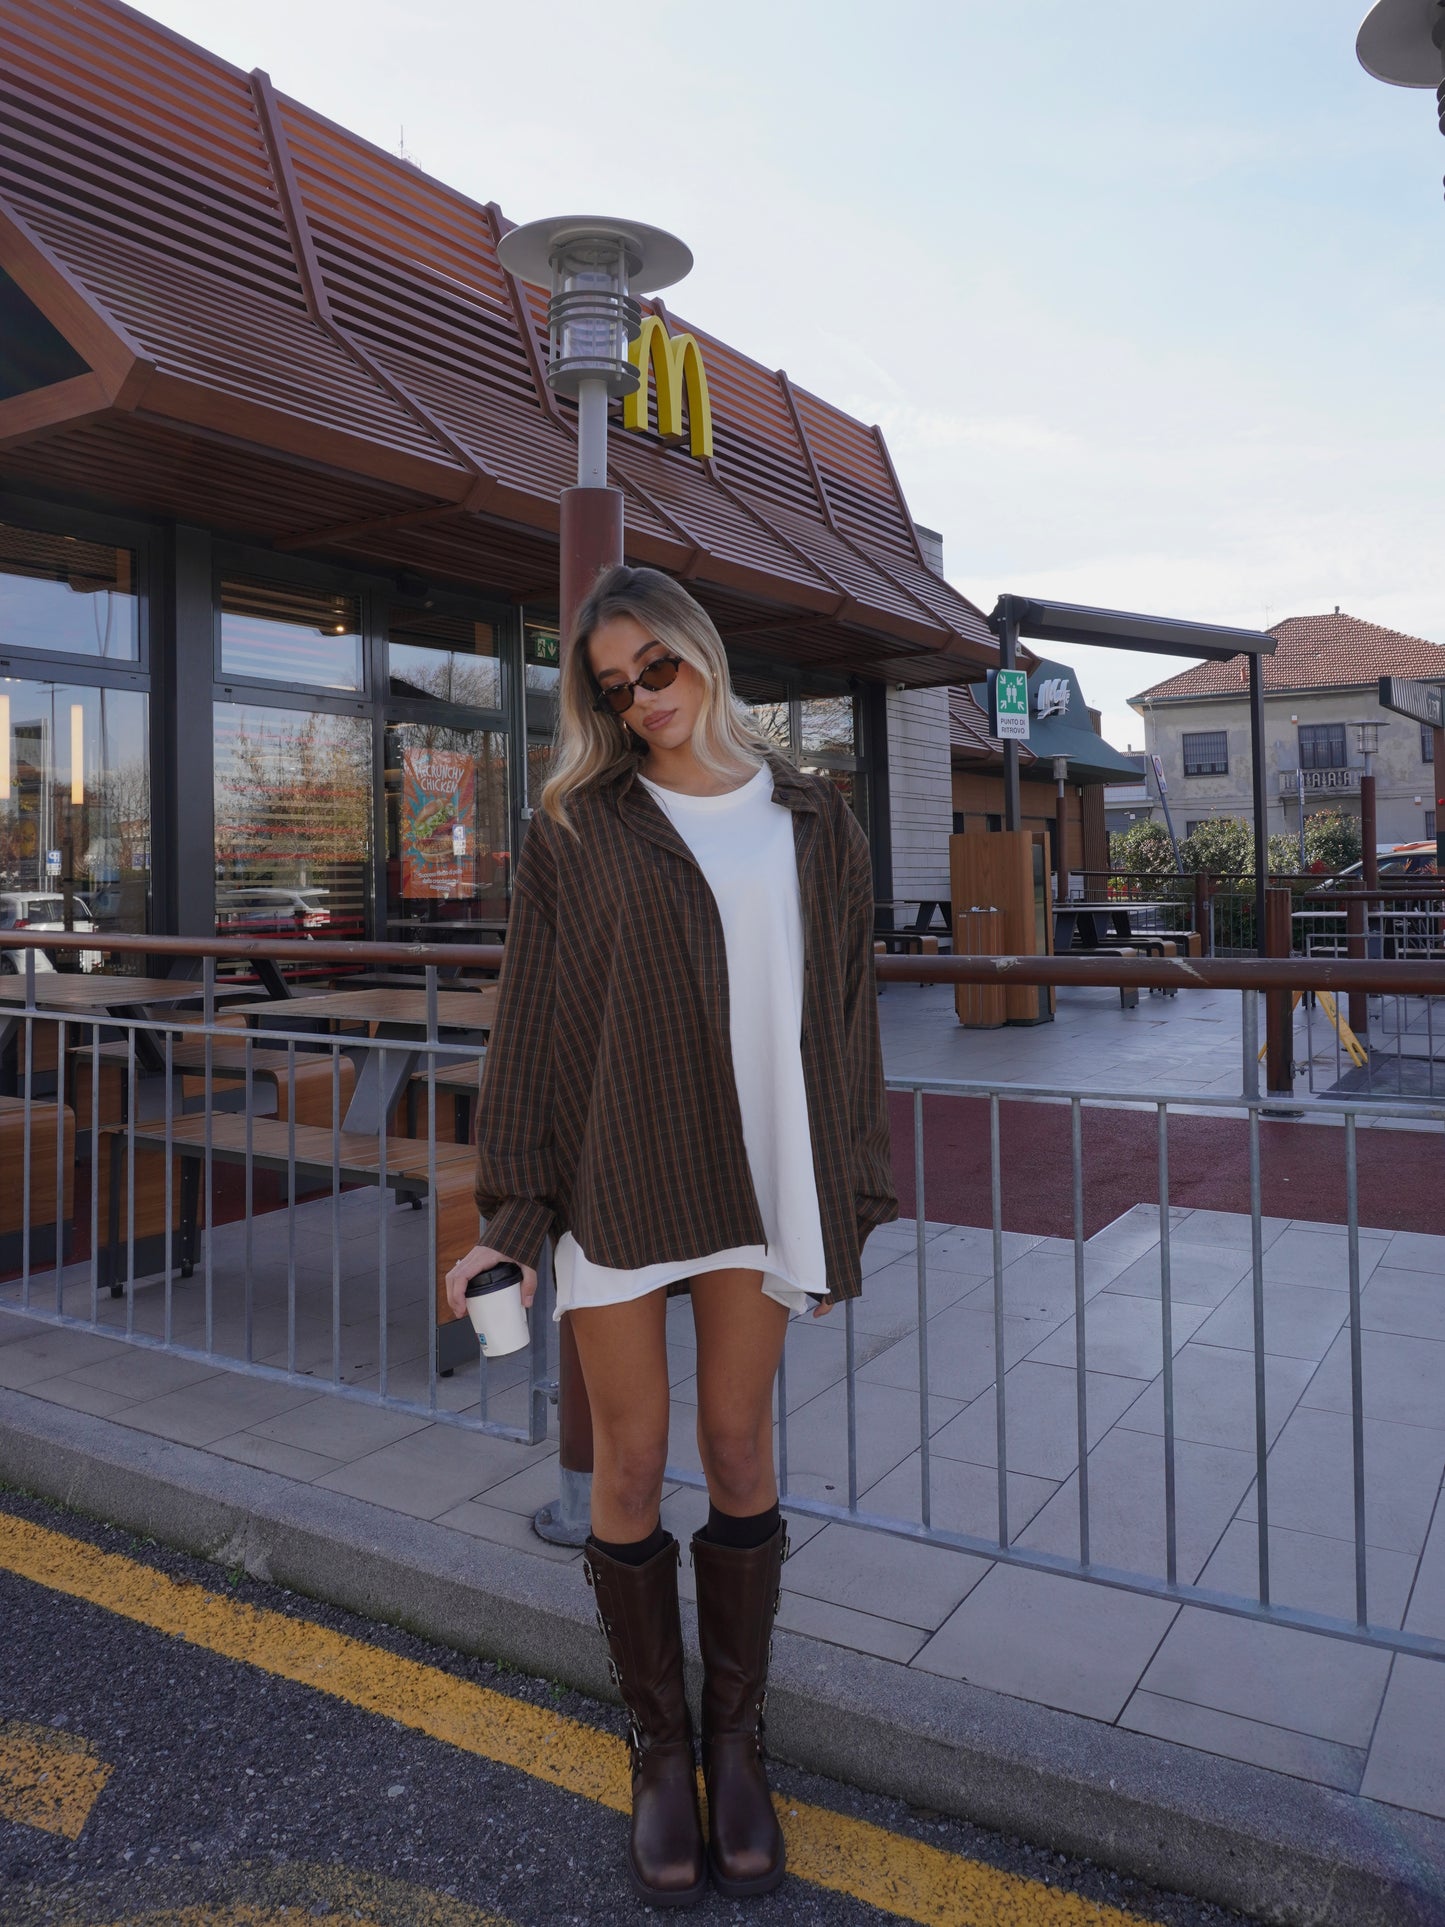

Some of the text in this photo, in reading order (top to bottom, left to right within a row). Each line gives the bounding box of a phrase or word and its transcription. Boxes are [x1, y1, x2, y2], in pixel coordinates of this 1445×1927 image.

[624, 315, 713, 460] M
[1000, 718, 1018, 726] PUNTO
[1001, 726, 1025, 734] RITROVO
[420, 778, 458, 793] CHICKEN
